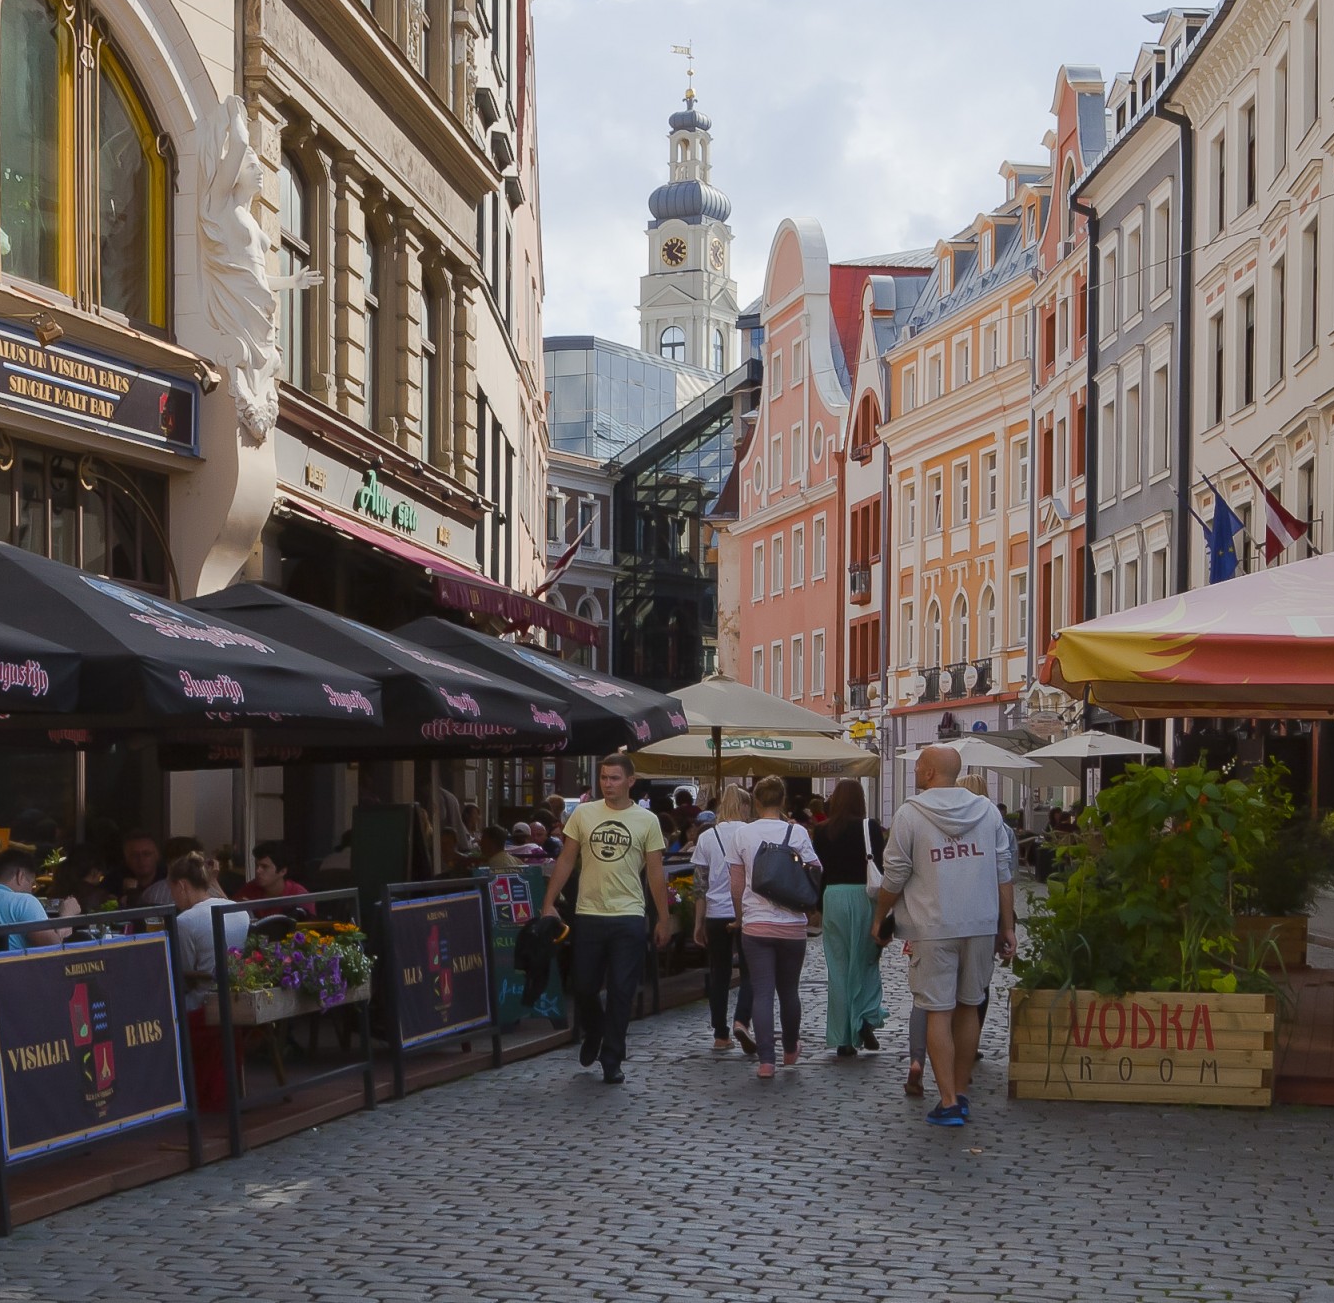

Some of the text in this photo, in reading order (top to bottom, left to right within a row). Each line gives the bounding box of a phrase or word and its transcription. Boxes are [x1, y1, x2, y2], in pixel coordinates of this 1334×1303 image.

[28, 348, 47, 369] UN
[49, 355, 97, 385] VISKIJA
[99, 370, 130, 394] BĀRS
[9, 375, 114, 420] SINGLE MALT BAR
[360, 469, 391, 518] Alus
[179, 670, 244, 704] Augustijn
[322, 683, 374, 716] Augustijn
[930, 843, 984, 863] DSRL
[125, 1019, 163, 1047] BĀRS
[1070, 1000, 1215, 1051] VODKA
[8, 1039, 70, 1072] VISKIJA
